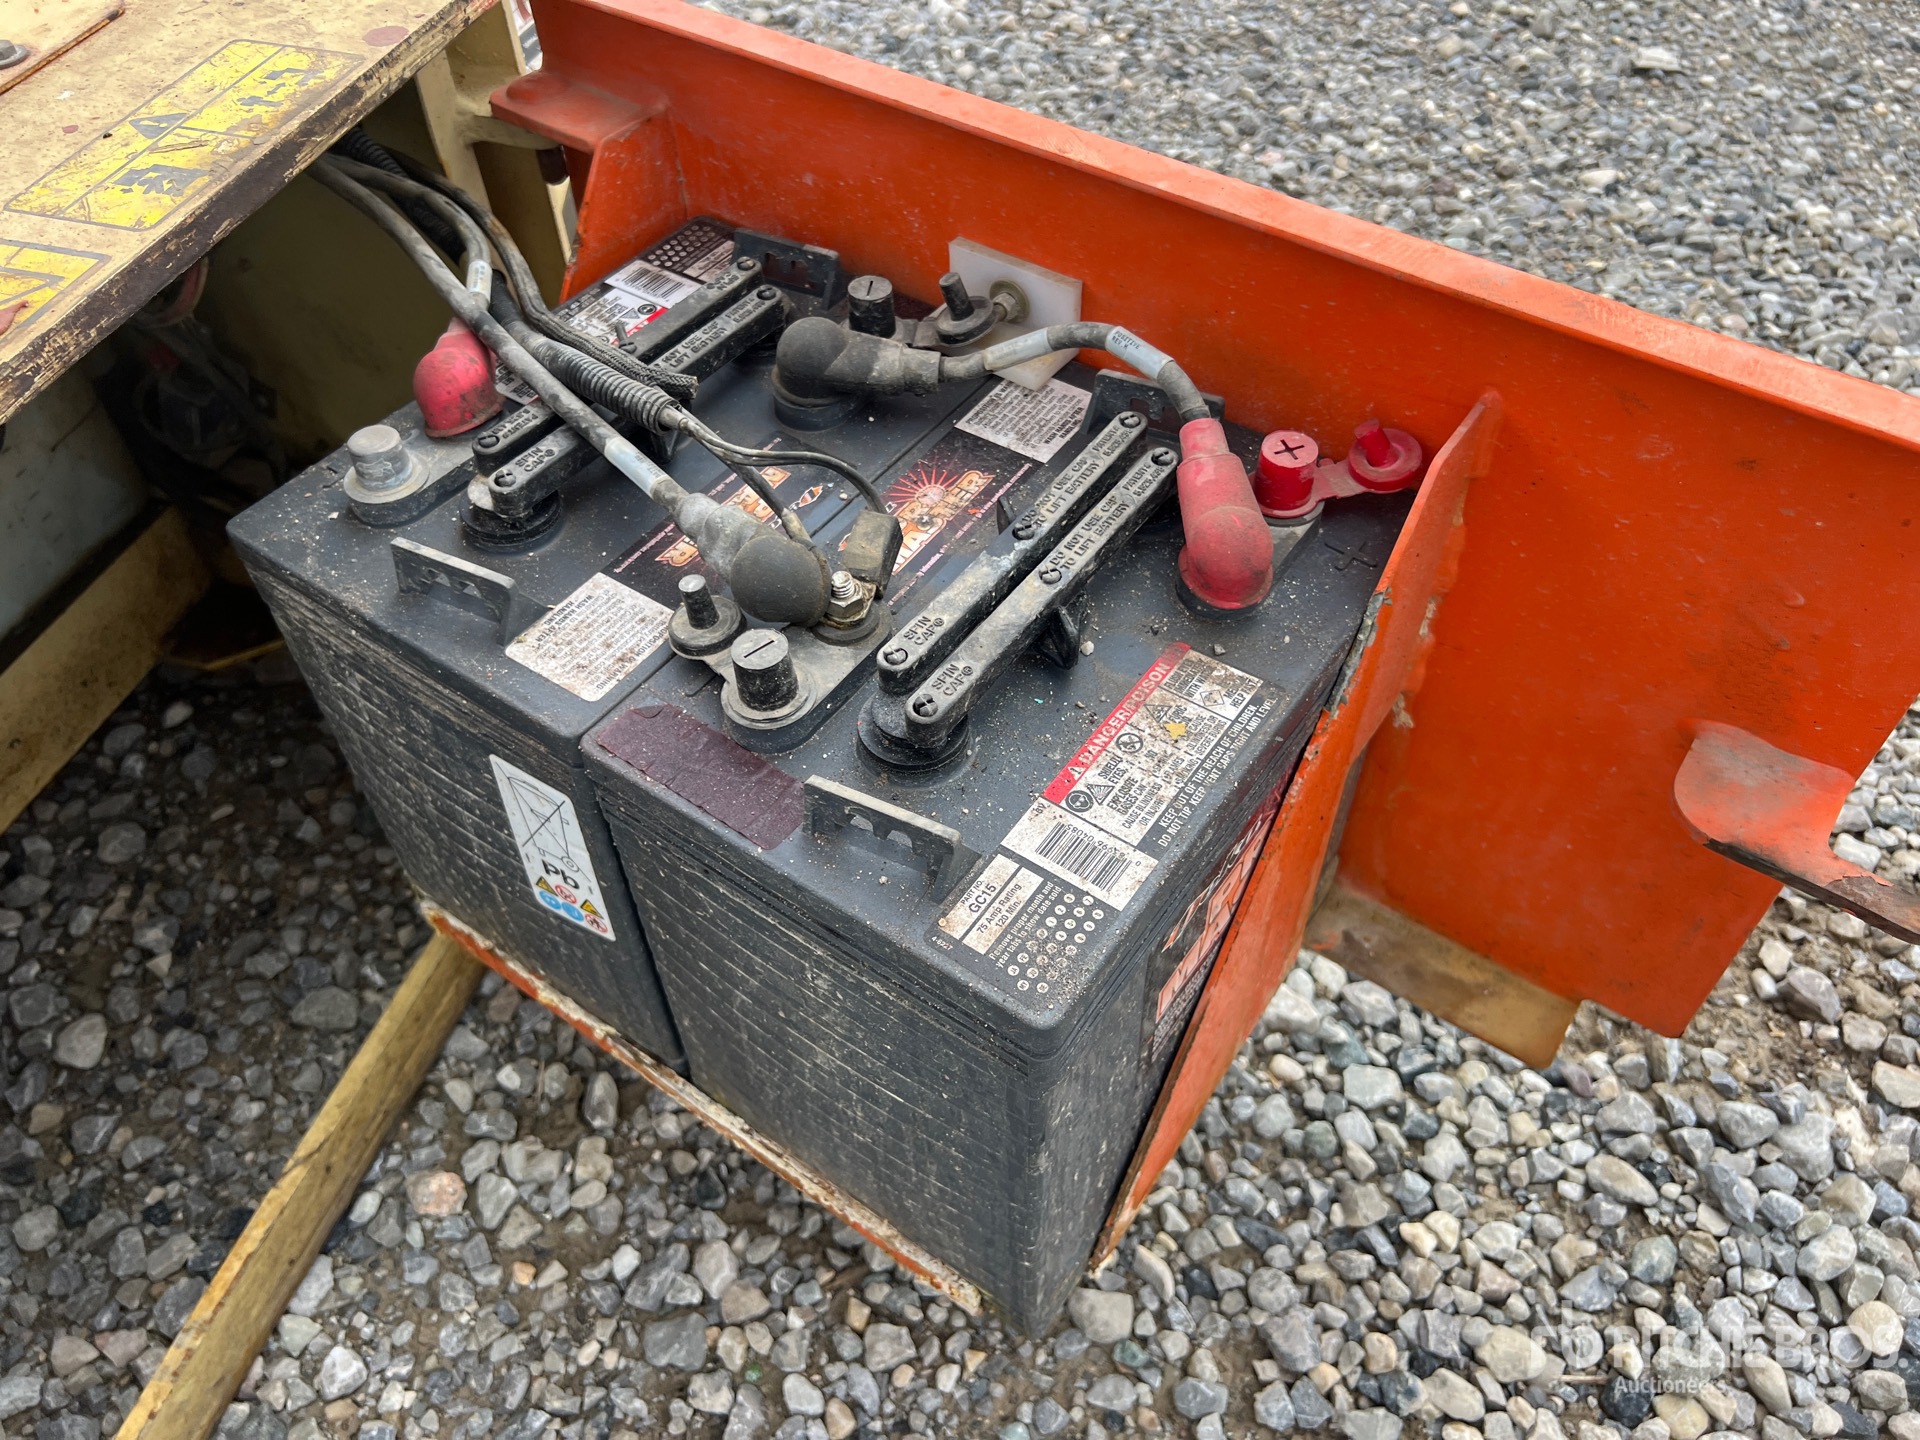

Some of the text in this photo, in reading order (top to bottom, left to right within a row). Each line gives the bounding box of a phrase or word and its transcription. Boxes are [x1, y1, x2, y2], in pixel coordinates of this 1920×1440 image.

[1044, 431, 1058, 444] WASH
[1068, 406, 1084, 420] AFTER
[514, 447, 543, 467] SPIN
[1032, 460, 1100, 528] TO LIFT BATTERY
[1036, 490, 1055, 508] NOT
[1053, 472, 1073, 491] USE
[1071, 456, 1090, 473] CAP
[1050, 495, 1118, 566] DO NOT USE CAP
[1060, 500, 1128, 572] TO LIFT BATTERY
[535, 594, 592, 642] WASH HANDS AFTER
[903, 614, 931, 642] SPIN
[596, 663, 626, 690] WARNING
[931, 661, 959, 691] SPIN
[1183, 681, 1202, 698] WITH
[1079, 664, 1169, 763] DANGER/POISON
[1229, 692, 1247, 708] HELP
[1189, 714, 1206, 731] CAUSE
[1205, 714, 1218, 724] OR
[1158, 702, 1258, 827] KEEP OUT OF THE REACH OF CHILDREN.
[1158, 694, 1278, 848] DO NOT TIP. KEEP VENT CAPS TIGHT AND LEVEL.
[1106, 775, 1138, 810] EXPLOSIVE
[1122, 810, 1140, 829] CAUSE
[1135, 782, 1162, 811] BLINDNESS
[1132, 782, 1148, 798] CAN
[1066, 823, 1094, 842] 04085
[1137, 814, 1150, 827] OR
[1096, 839, 1125, 859] 83996
[542, 859, 580, 890] Pb
[960, 888, 974, 904] PART
[968, 882, 996, 913] GC15
[976, 882, 1021, 935] 75 Amp Rating
[989, 932, 1012, 960] Remove
[1010, 913, 1029, 934] proper
[1026, 893, 1044, 913] month
[1040, 881, 1054, 895] and
[994, 914, 1008, 928] 120
[1006, 898, 1022, 914] Min.
[994, 951, 1010, 968] year
[1006, 936, 1020, 952] tabs
[1017, 929, 1027, 939] to
[1024, 913, 1040, 930] show
[1036, 898, 1050, 914] date
